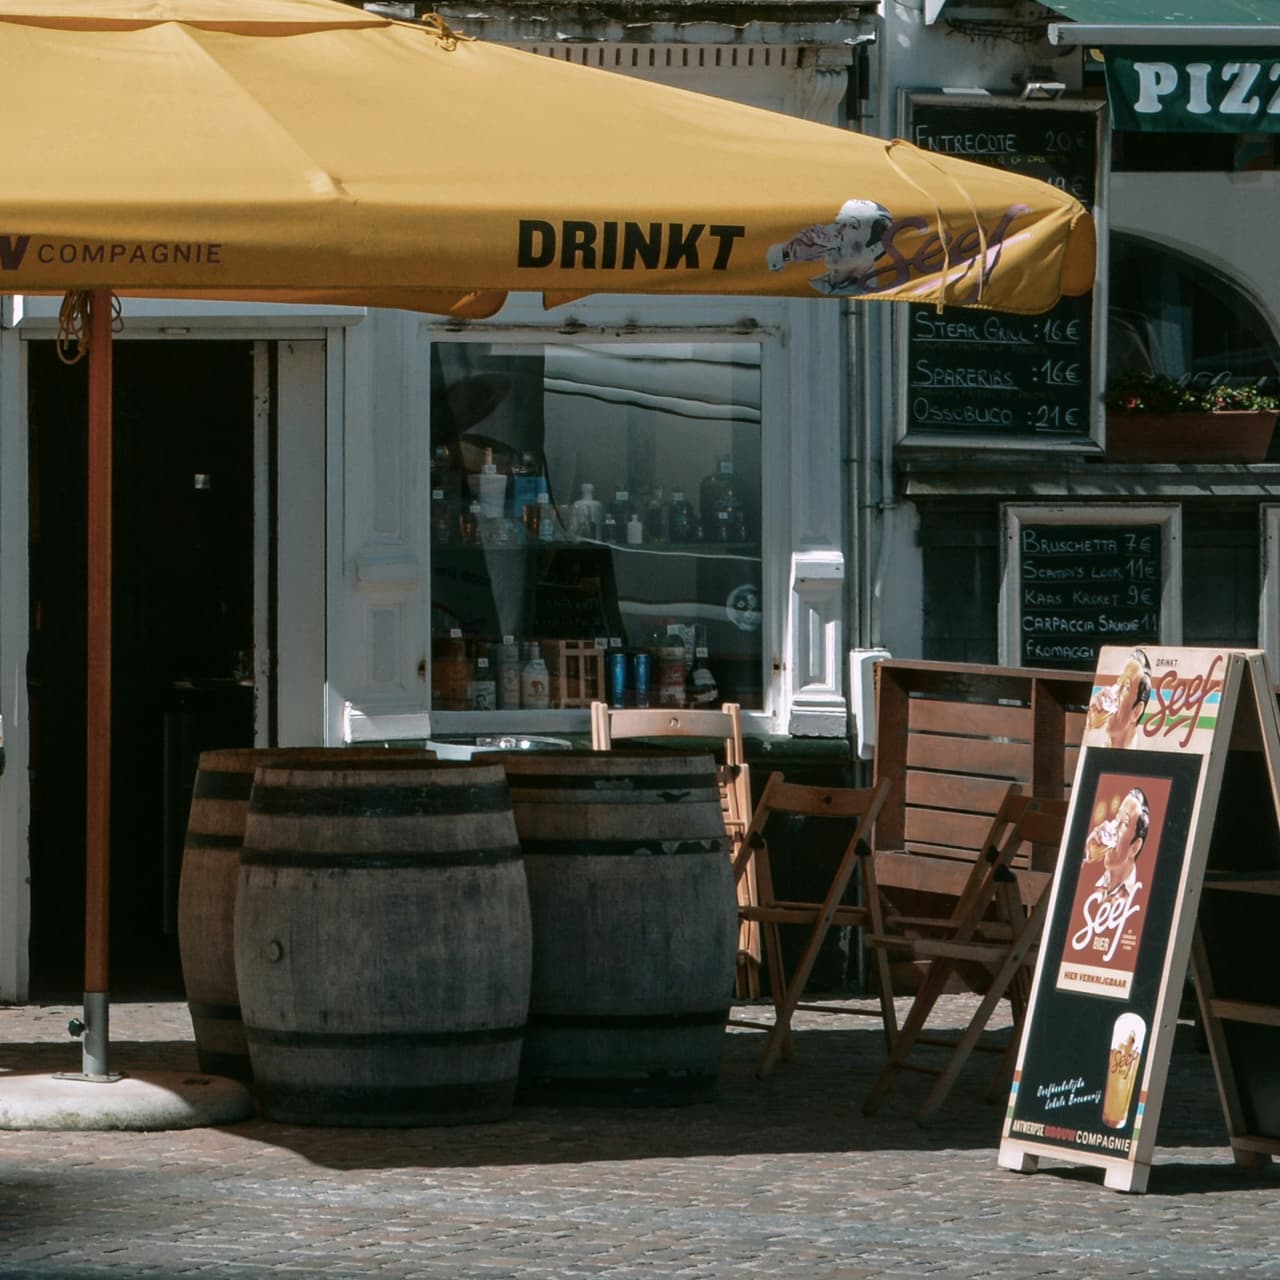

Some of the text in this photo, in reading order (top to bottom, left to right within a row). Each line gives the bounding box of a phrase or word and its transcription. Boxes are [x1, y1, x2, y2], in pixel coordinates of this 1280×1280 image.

[37, 243, 222, 265] COMPAGNIE
[517, 219, 746, 271] DRINKT
[1022, 529, 1118, 553] BRUSCHETTA
[1142, 654, 1224, 749] Seef
[1071, 881, 1143, 962] Seef
[1075, 1130, 1132, 1152] COMPAGNIE
